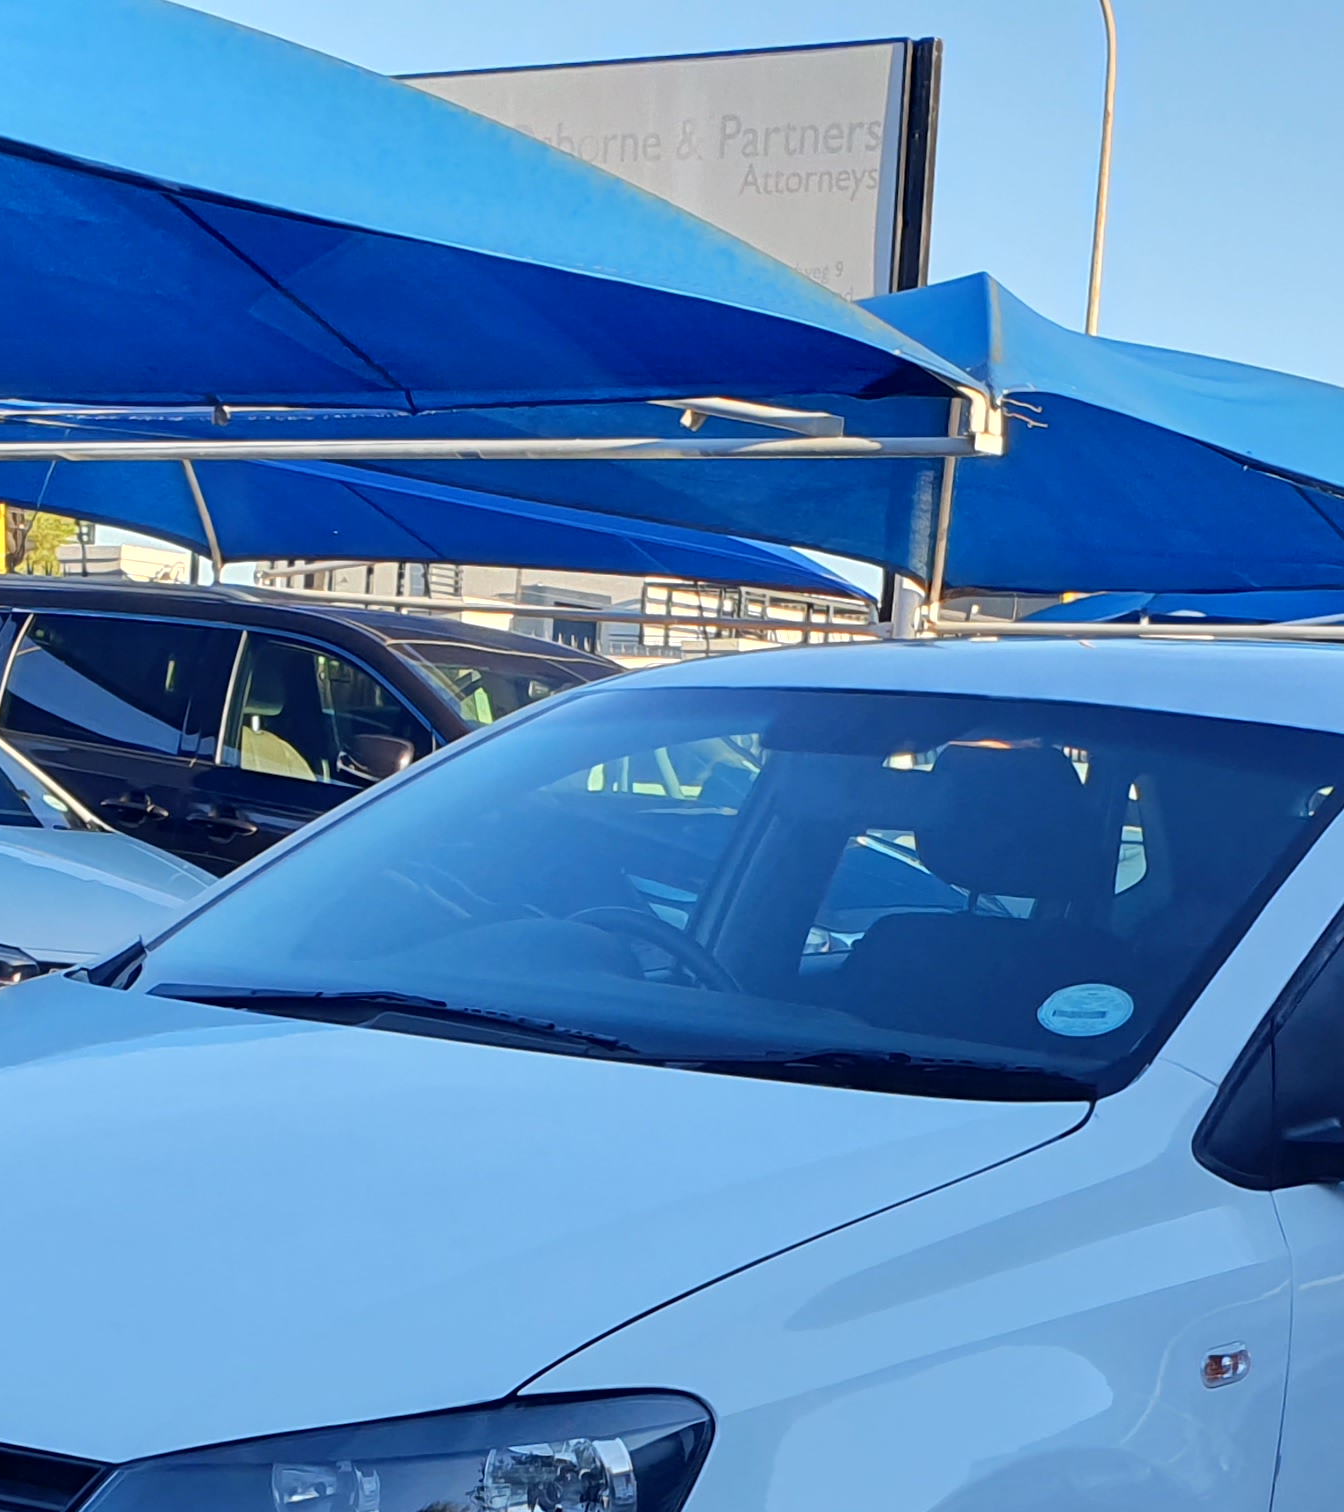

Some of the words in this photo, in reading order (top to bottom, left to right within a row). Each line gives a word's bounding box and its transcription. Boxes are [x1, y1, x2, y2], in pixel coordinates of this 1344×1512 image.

[513, 121, 662, 165] borne
[676, 118, 702, 161] &
[719, 114, 882, 159] Partners
[740, 163, 878, 201] Attorneys
